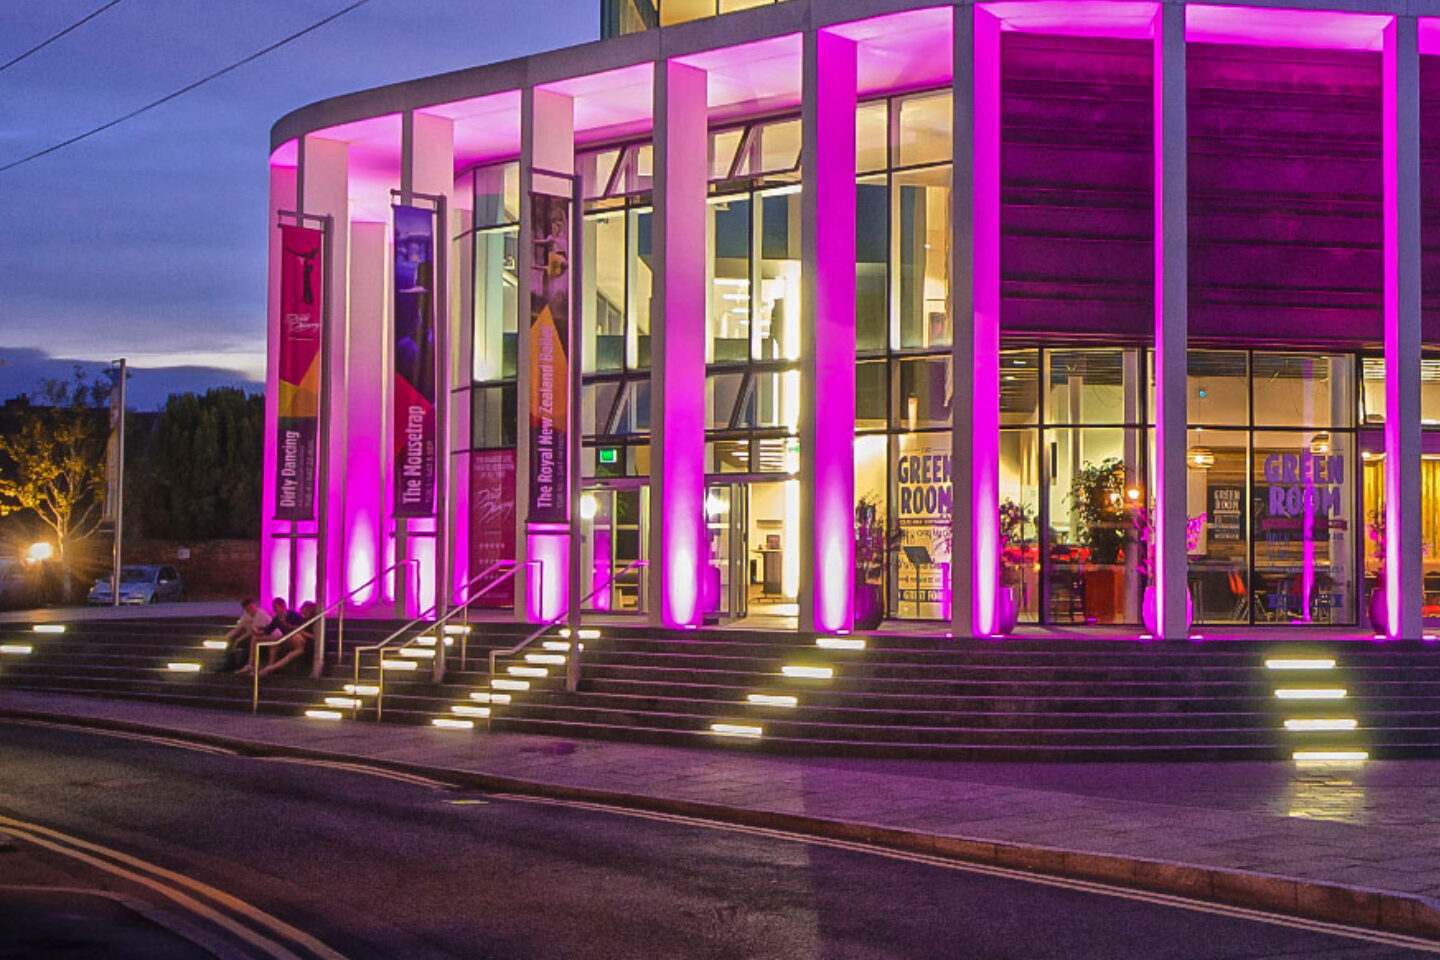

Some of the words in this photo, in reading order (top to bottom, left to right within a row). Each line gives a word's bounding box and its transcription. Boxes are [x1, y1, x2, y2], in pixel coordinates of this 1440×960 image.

[538, 325, 554, 362] Ballet
[537, 364, 554, 415] Zealand
[403, 406, 426, 476] Mousetrap
[538, 416, 554, 445] New
[281, 430, 300, 476] Dancing
[537, 448, 555, 483] Royal
[1264, 453, 1344, 484] GREEN
[898, 455, 952, 484] GREEN
[280, 479, 299, 507] Dirty
[402, 480, 421, 504] The
[537, 485, 554, 508] The
[901, 485, 953, 514] ROOM
[1268, 486, 1341, 517] ROOM
